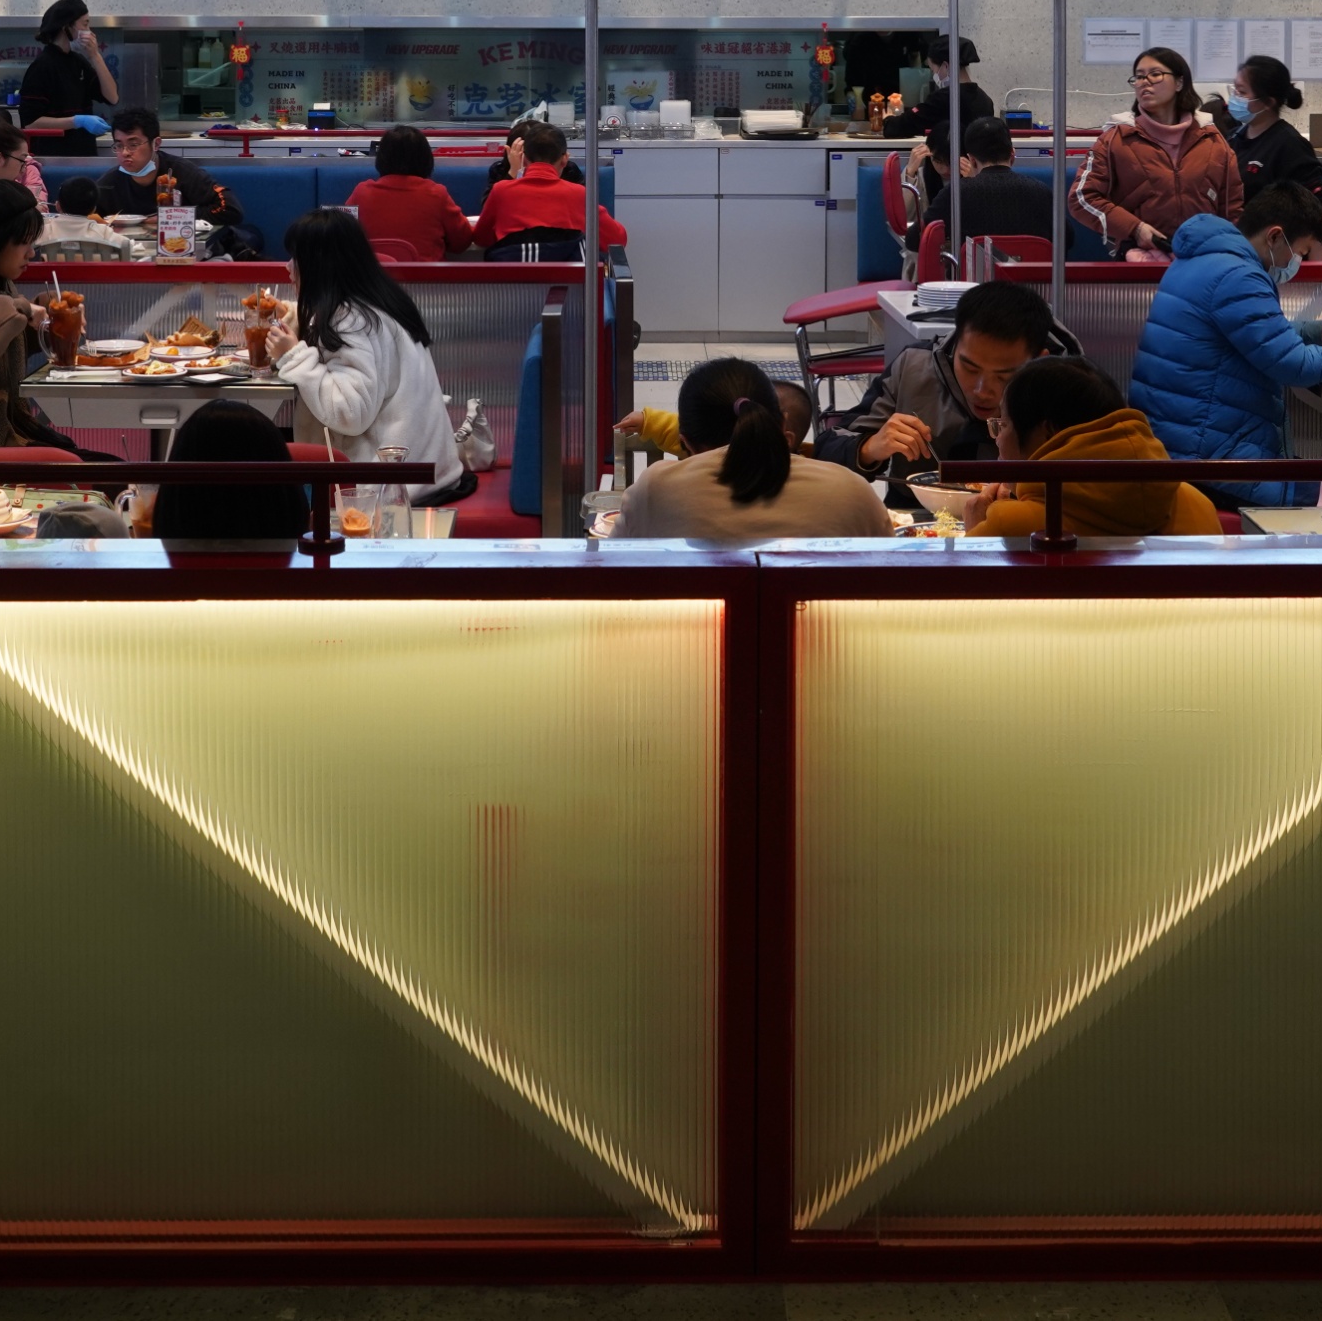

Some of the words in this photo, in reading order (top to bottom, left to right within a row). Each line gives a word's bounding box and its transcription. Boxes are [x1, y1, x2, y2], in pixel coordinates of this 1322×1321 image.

[386, 45, 409, 55] NEW
[412, 44, 461, 55] UPGRADE
[478, 42, 514, 67] KE
[630, 44, 678, 55] UPGRADE
[765, 82, 794, 90] CHINA
